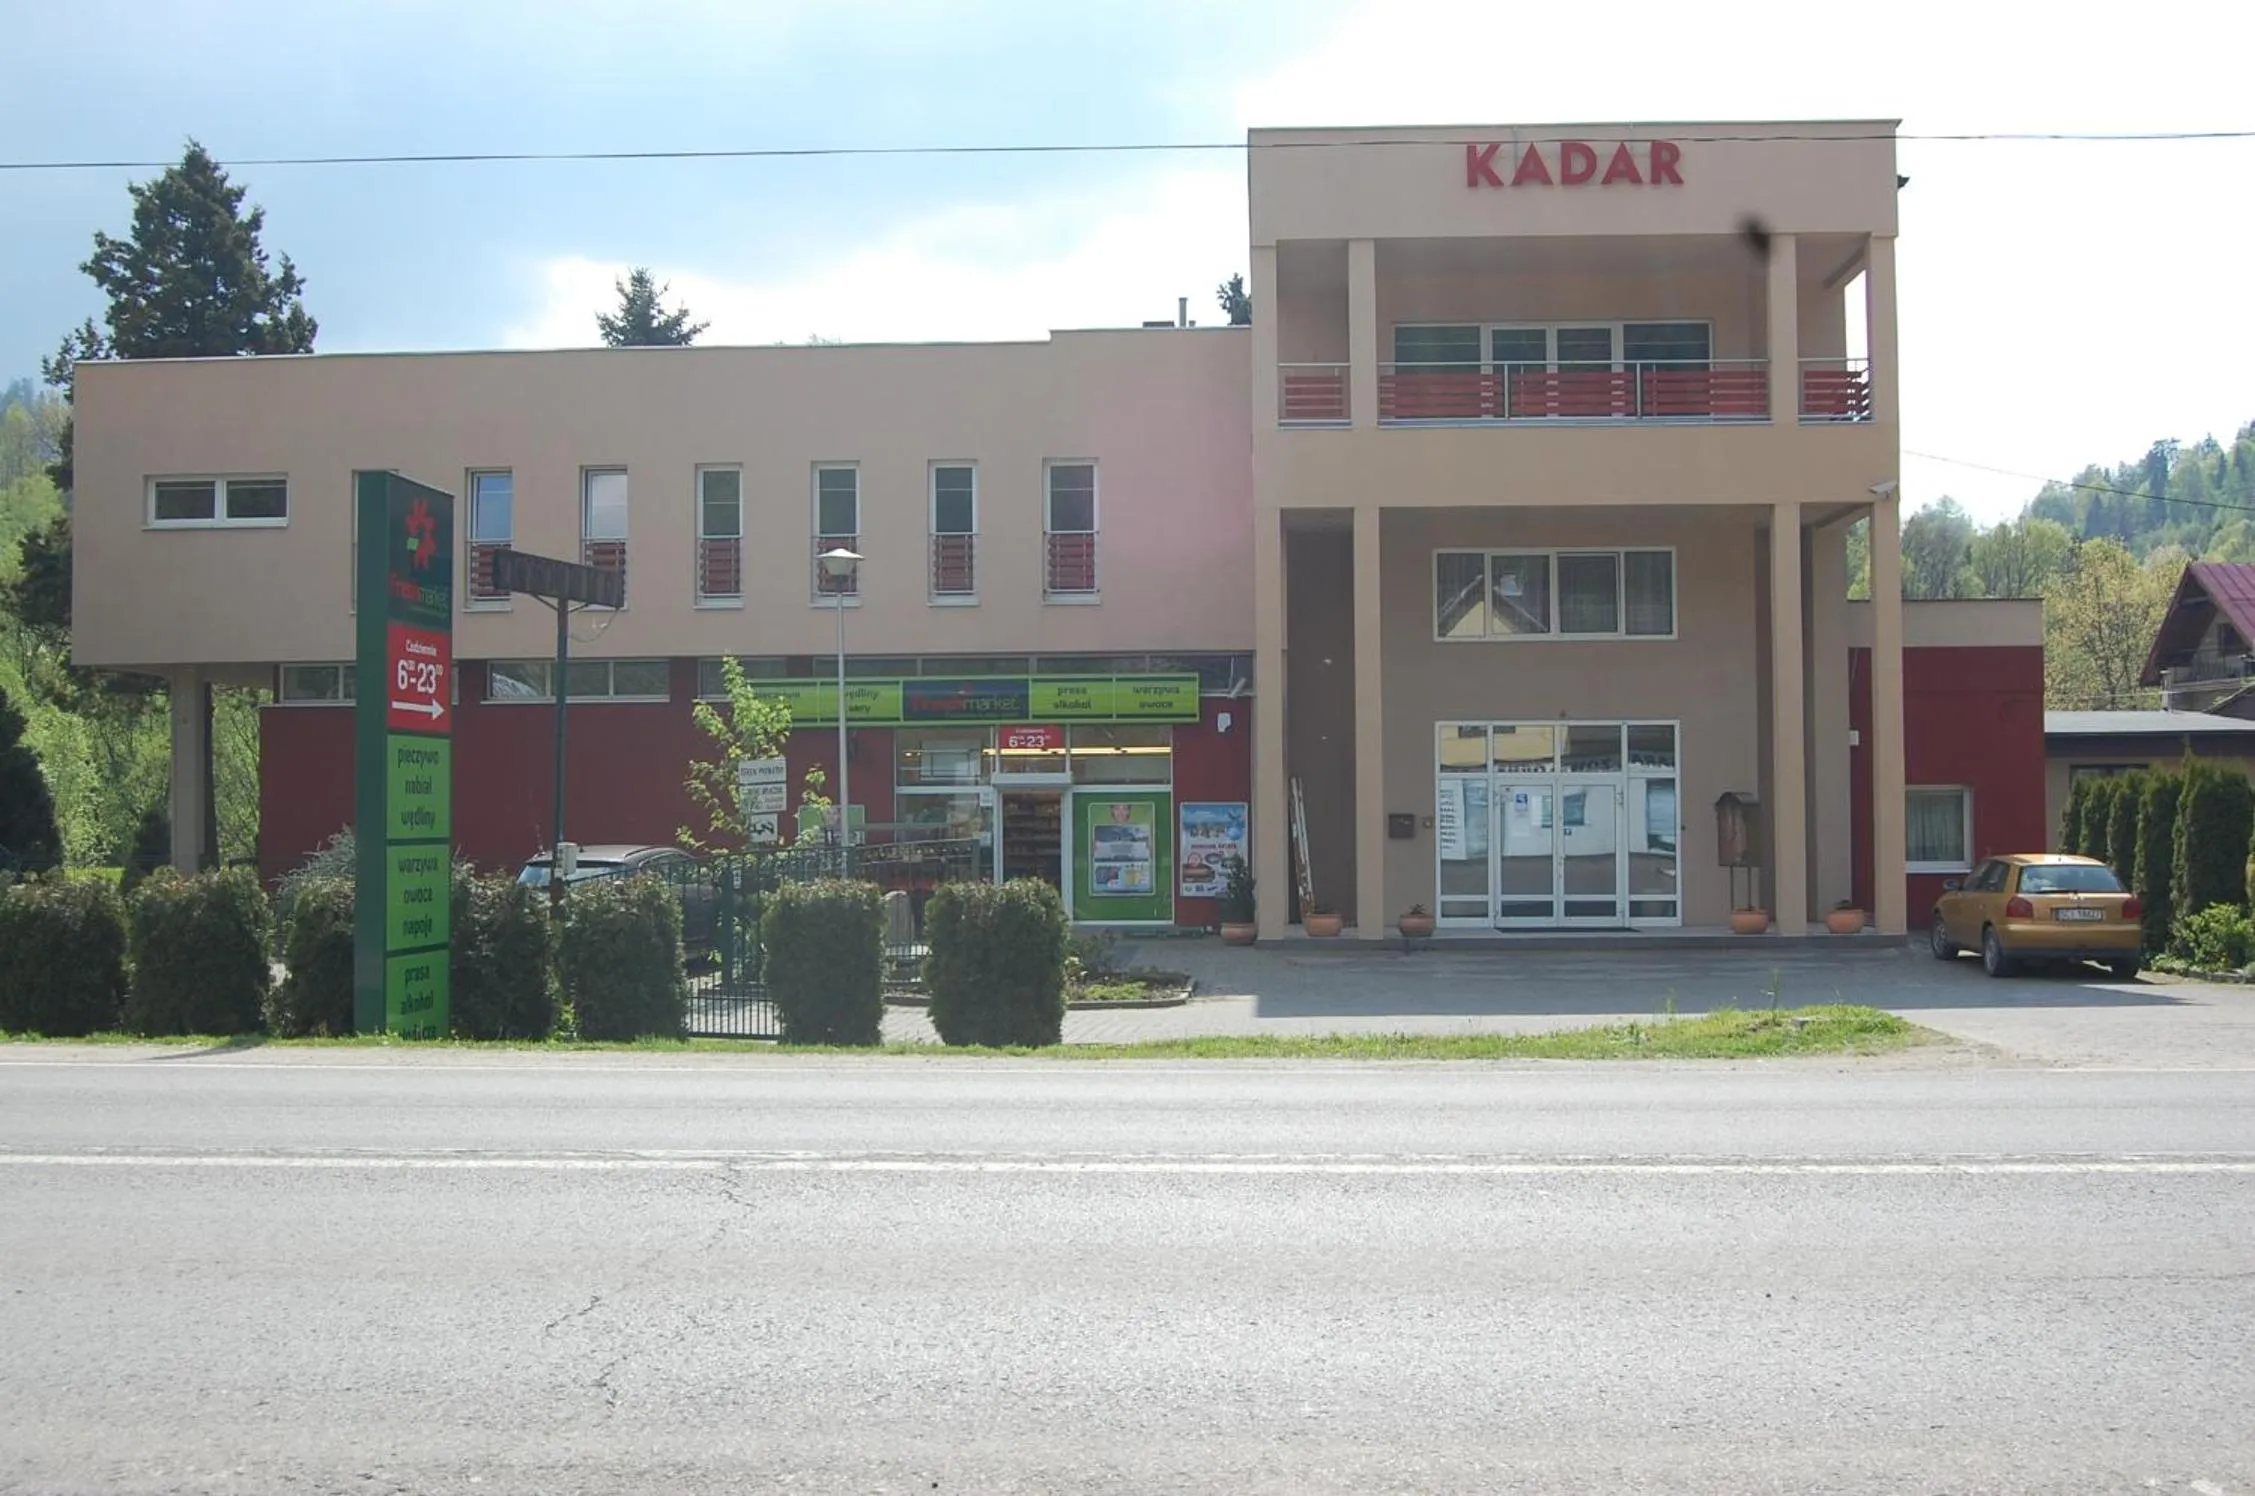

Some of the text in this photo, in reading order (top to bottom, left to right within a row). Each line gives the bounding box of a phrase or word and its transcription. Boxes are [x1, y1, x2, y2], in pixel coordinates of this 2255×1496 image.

[1466, 140, 1684, 187] KADAR
[397, 744, 439, 771] pieczywo
[404, 776, 432, 795] nabiał
[401, 806, 435, 831] wędliny
[398, 856, 439, 878] warzywa
[403, 886, 433, 904] owoce
[403, 914, 432, 938] napoje
[404, 964, 430, 987] prasa
[400, 990, 434, 1016] alkohol
